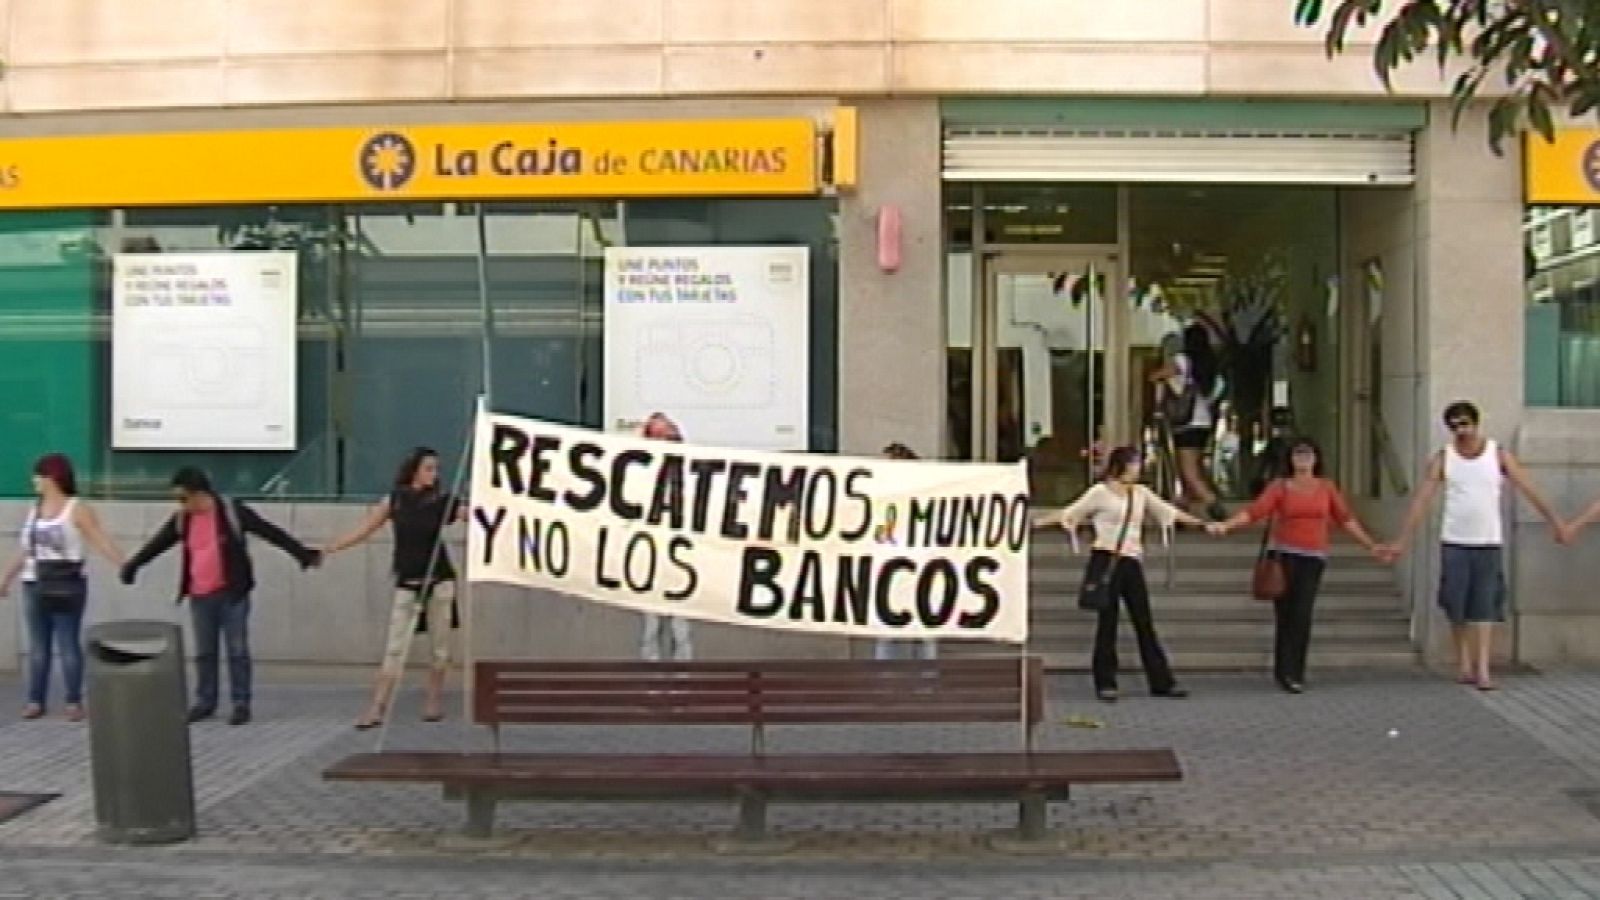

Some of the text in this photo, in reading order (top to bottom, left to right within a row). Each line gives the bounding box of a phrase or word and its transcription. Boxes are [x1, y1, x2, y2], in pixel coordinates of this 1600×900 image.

[435, 137, 787, 176] La Caja de CANARIAS
[490, 424, 873, 545] RESCATEMOS
[907, 490, 1028, 552] MUNDO
[474, 506, 1000, 629] Y NO LOS BANCOS
